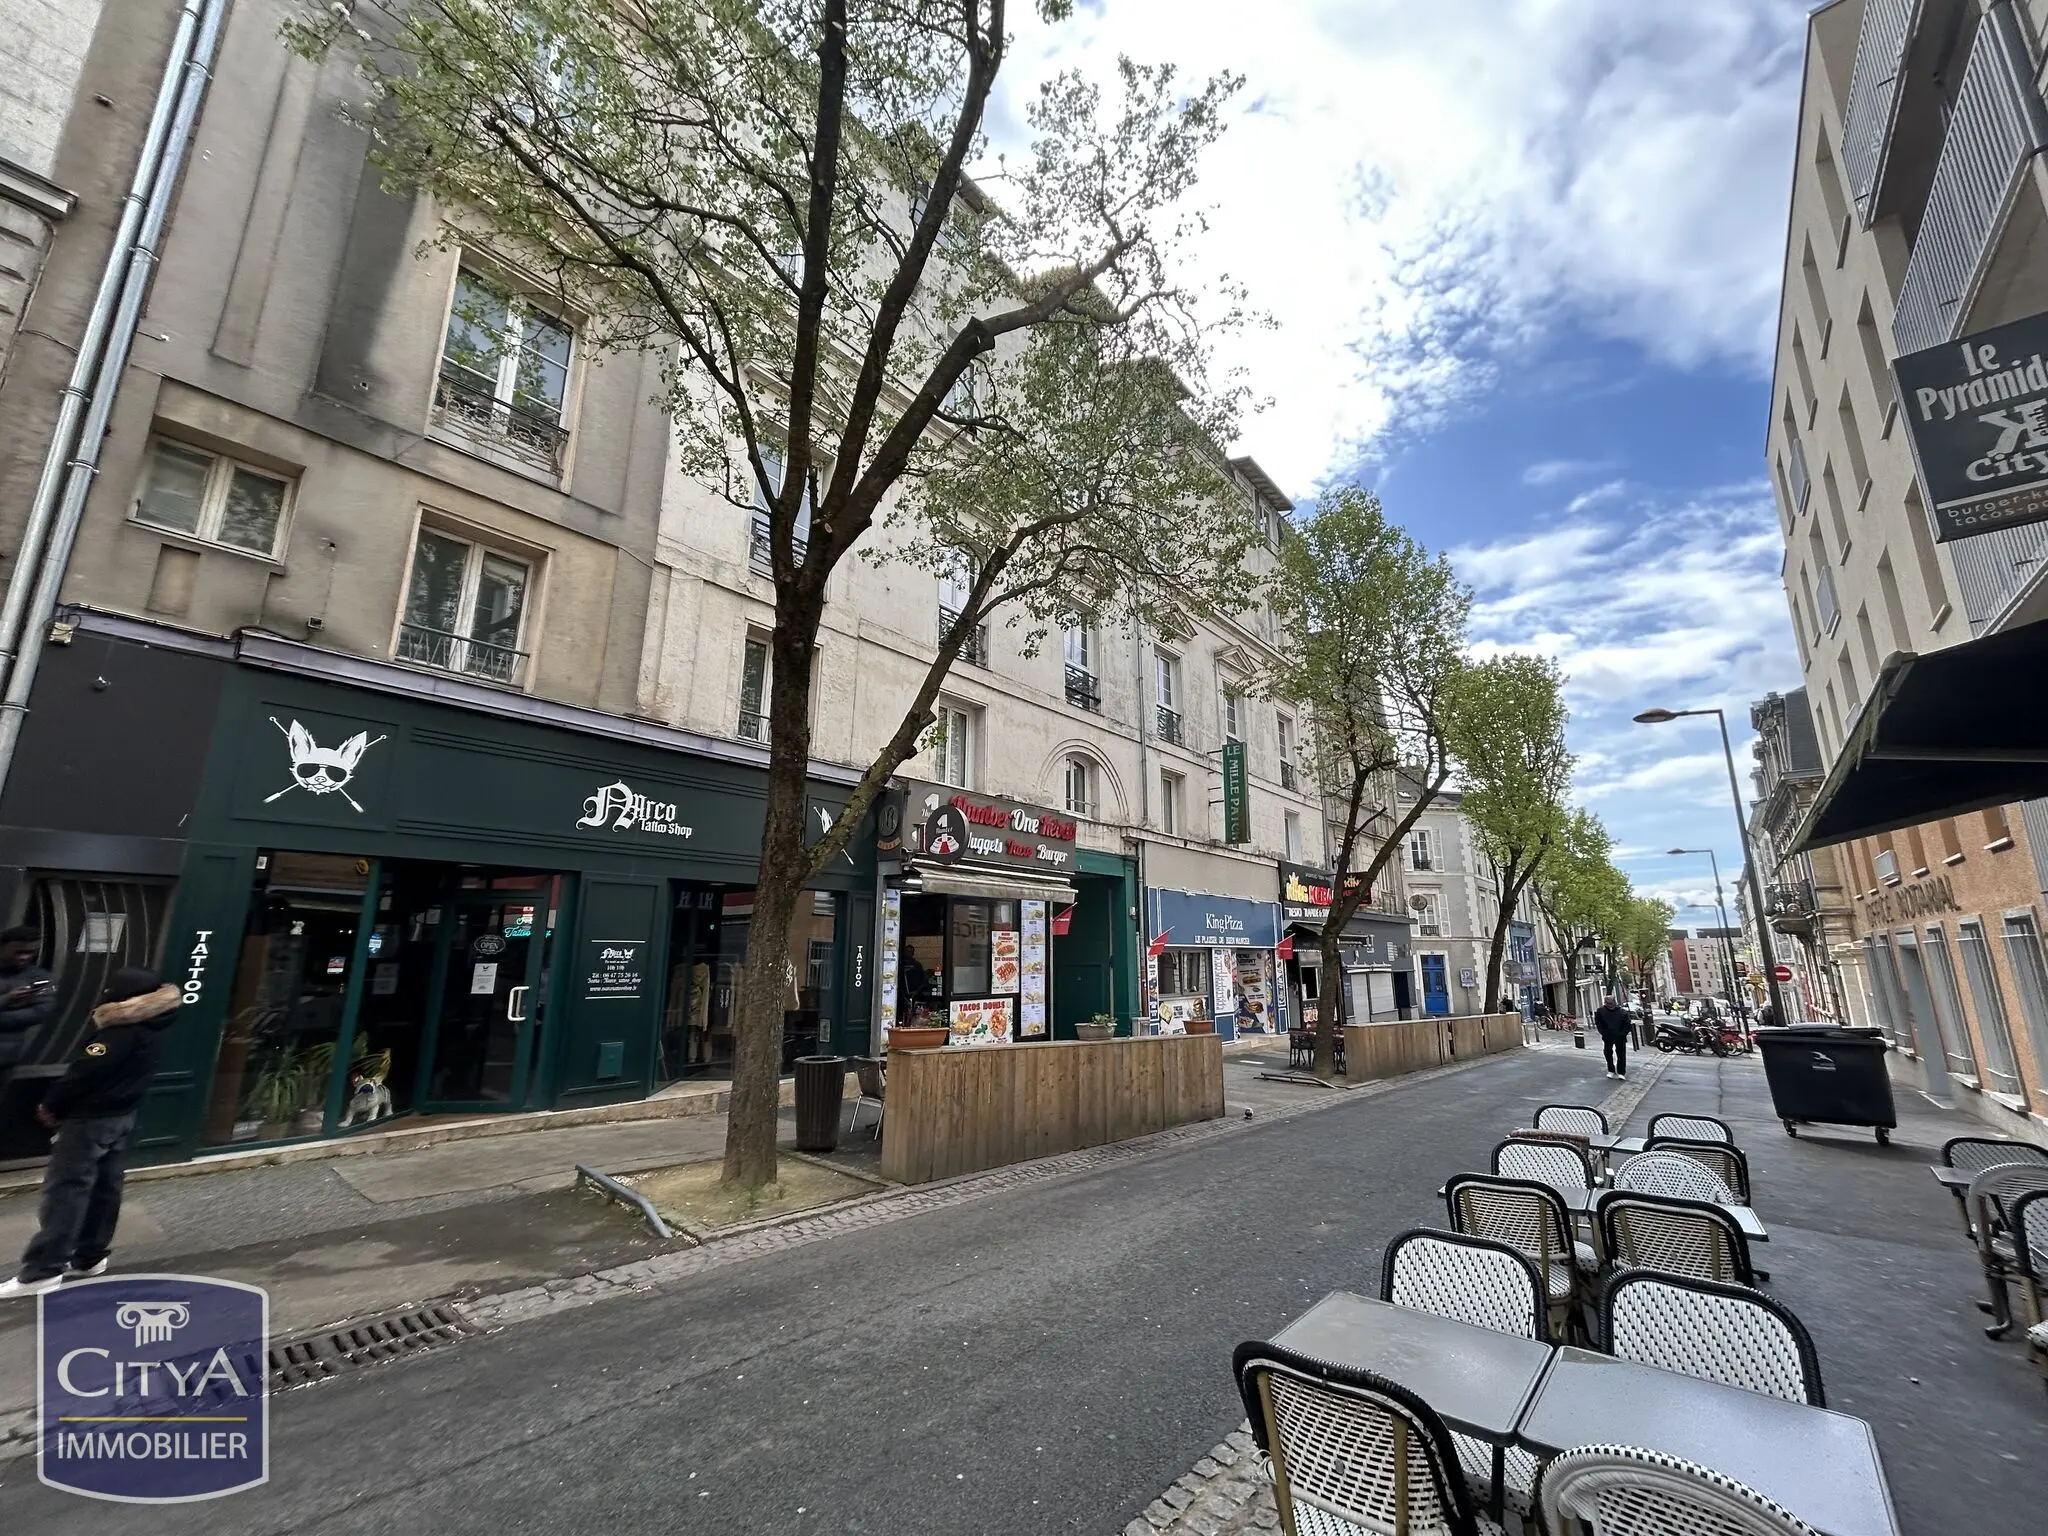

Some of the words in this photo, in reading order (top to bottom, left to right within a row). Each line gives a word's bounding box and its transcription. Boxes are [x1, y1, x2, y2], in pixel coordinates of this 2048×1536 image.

[1915, 353, 2048, 422] Pyramid
[1226, 745, 1240, 756] LE
[1229, 759, 1240, 796] MILLE
[639, 819, 667, 834] Tattoo
[667, 823, 693, 839] Shop
[1010, 808, 1040, 834] One
[1037, 843, 1069, 866] Burger
[1343, 878, 1361, 888] KIN
[1308, 884, 1335, 907] KEBA
[1205, 913, 1224, 933] King
[1224, 914, 1244, 931] Pizza
[183, 930, 213, 1004] TATTOO
[855, 945, 864, 987] TATTOO
[959, 1002, 981, 1012] TACOS
